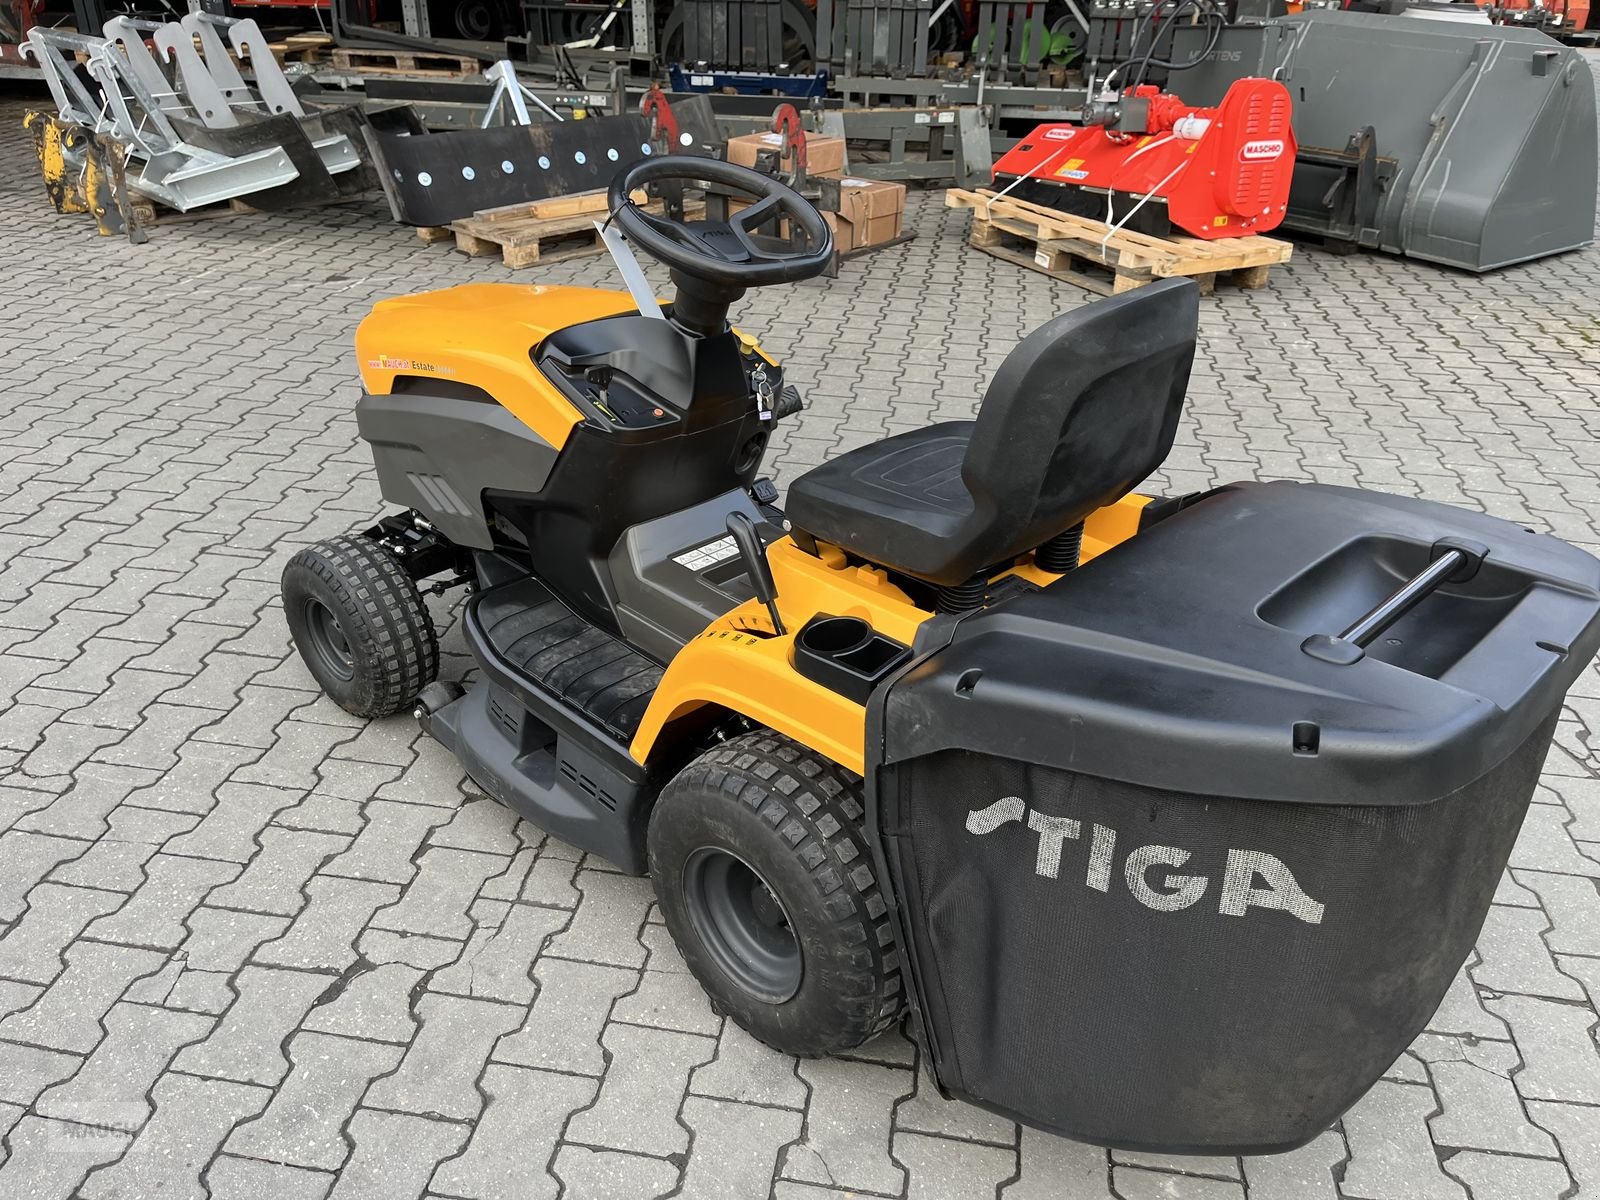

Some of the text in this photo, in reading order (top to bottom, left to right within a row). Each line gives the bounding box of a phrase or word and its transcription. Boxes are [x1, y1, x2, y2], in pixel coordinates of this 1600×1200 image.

[1246, 145, 1281, 154] MASCHIO
[412, 360, 435, 372] Estate
[965, 796, 1326, 925] STIGA
